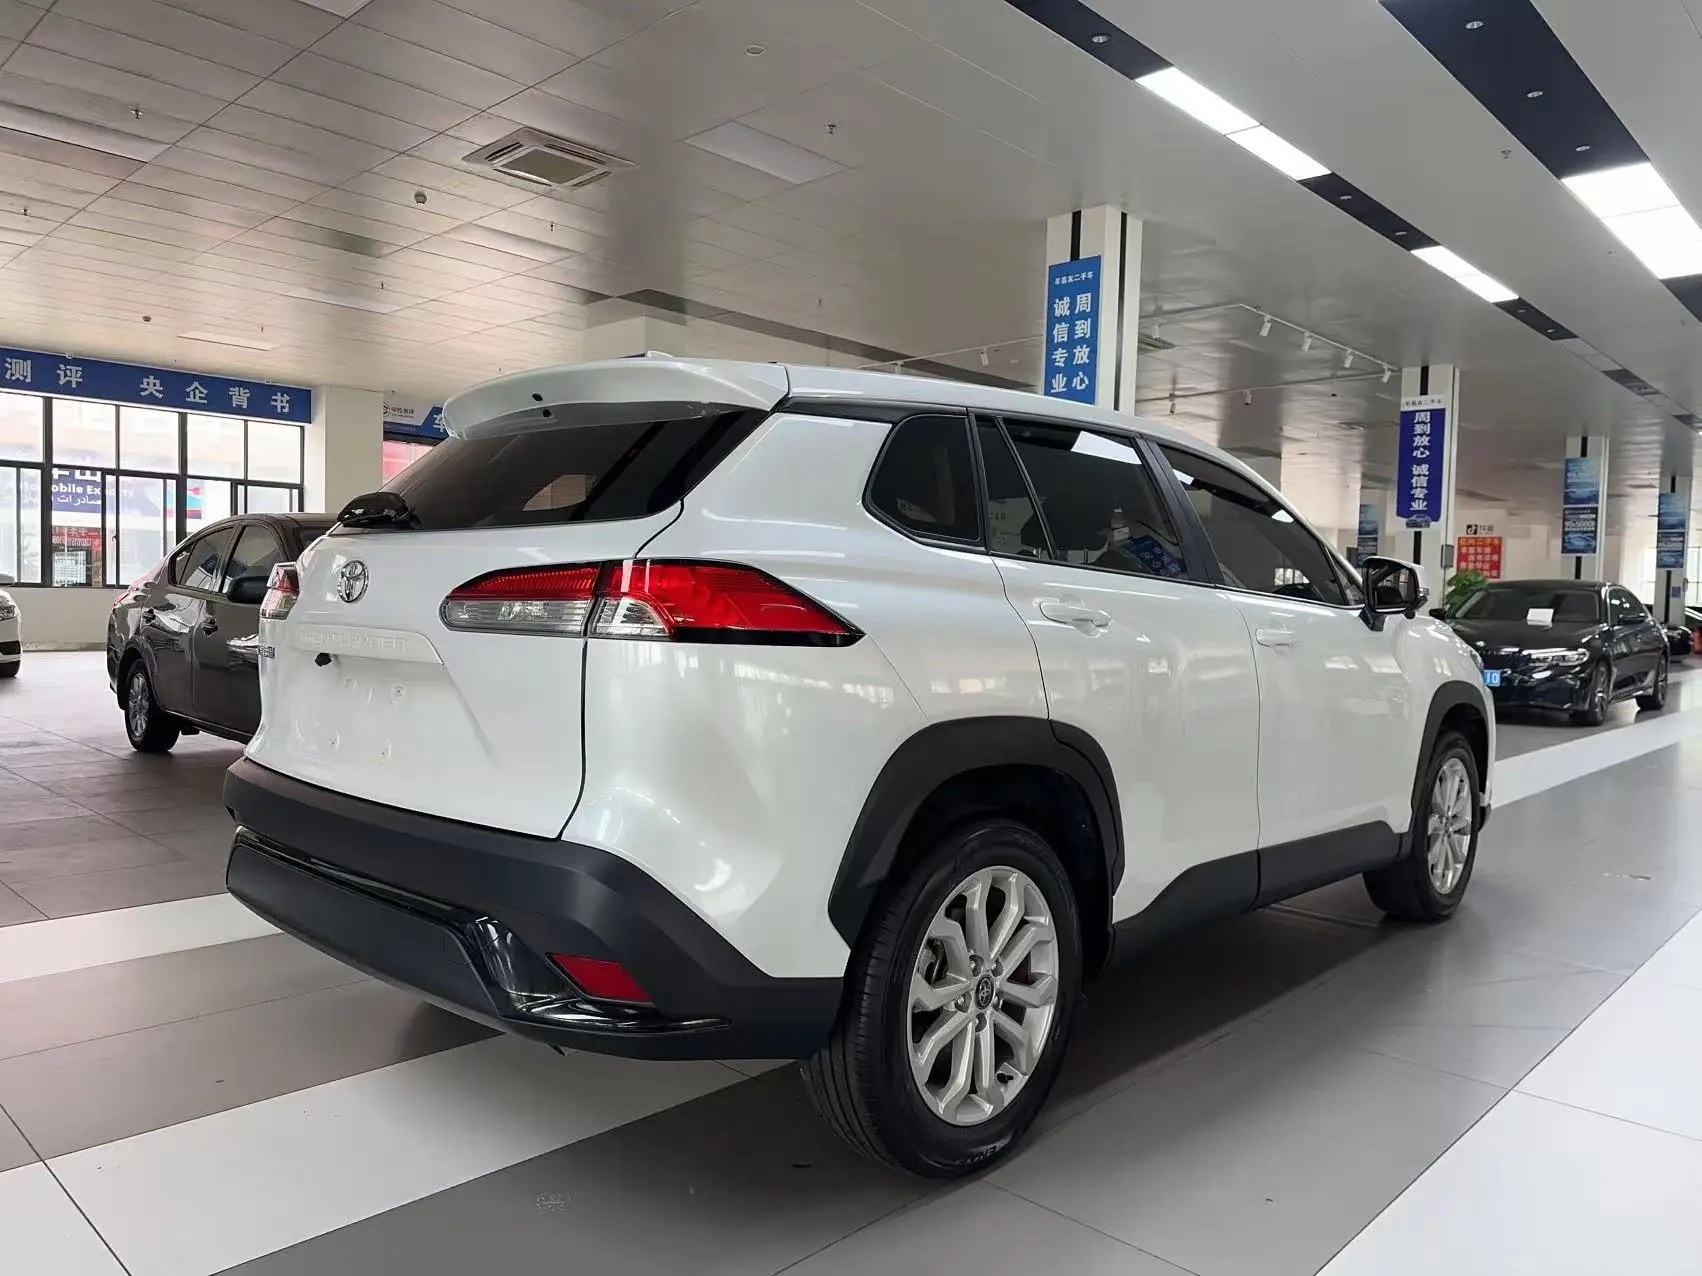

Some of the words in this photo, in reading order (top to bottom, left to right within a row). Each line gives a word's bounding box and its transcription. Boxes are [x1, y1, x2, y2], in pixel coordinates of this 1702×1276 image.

[1050, 296, 1070, 393] 诚信专业
[1071, 292, 1092, 390] 周到放心
[4, 357, 83, 388] 测评
[140, 375, 291, 413] 央企背书
[1412, 411, 1431, 458] 周到放心
[1410, 464, 1430, 510] 诚信专业
